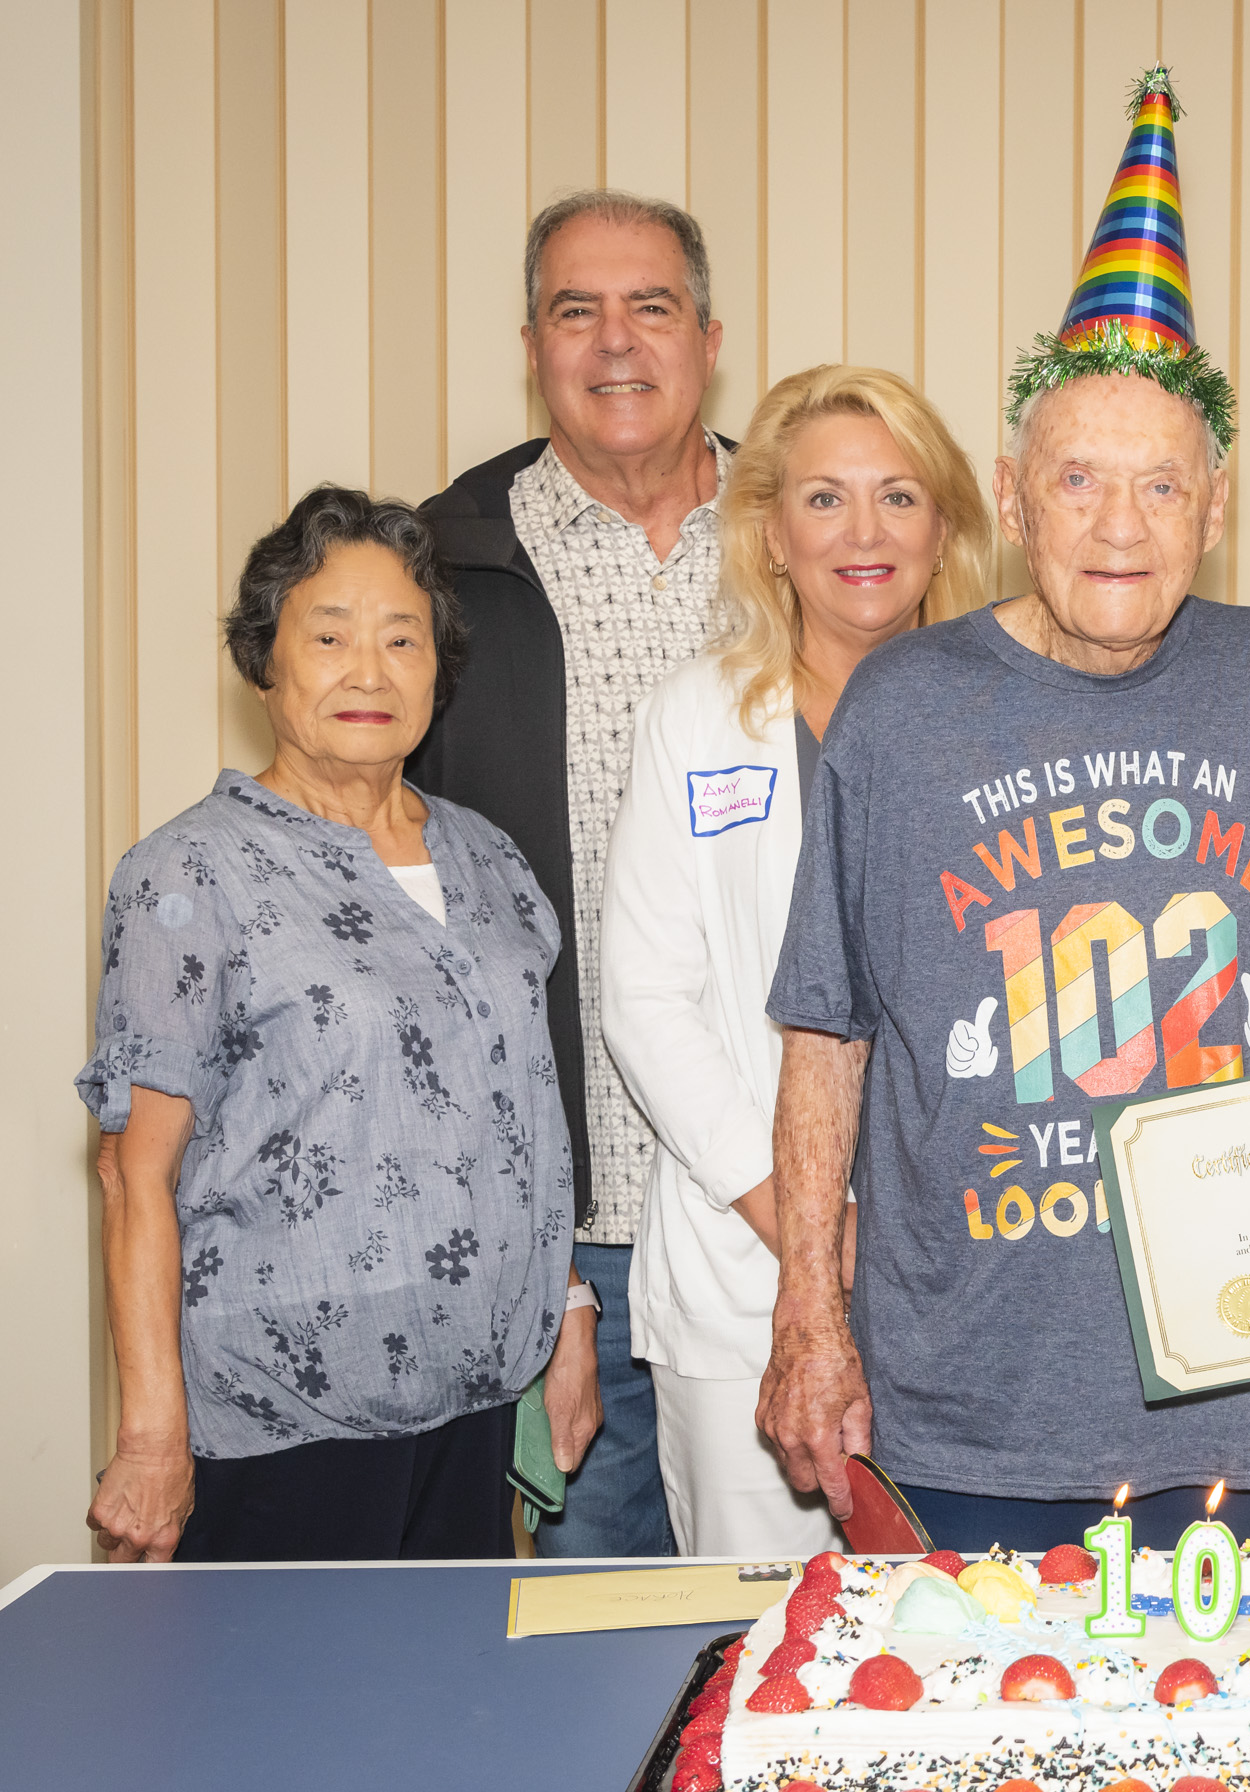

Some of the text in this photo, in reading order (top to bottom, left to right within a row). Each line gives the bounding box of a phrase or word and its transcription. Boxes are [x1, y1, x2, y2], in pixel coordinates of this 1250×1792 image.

[703, 777, 741, 797] AMY
[962, 750, 1237, 825] THIS IS WHAT AN
[698, 797, 762, 818] ROMANELLI
[984, 891, 1245, 1104] 102
[1238, 1232, 1249, 1243] In
